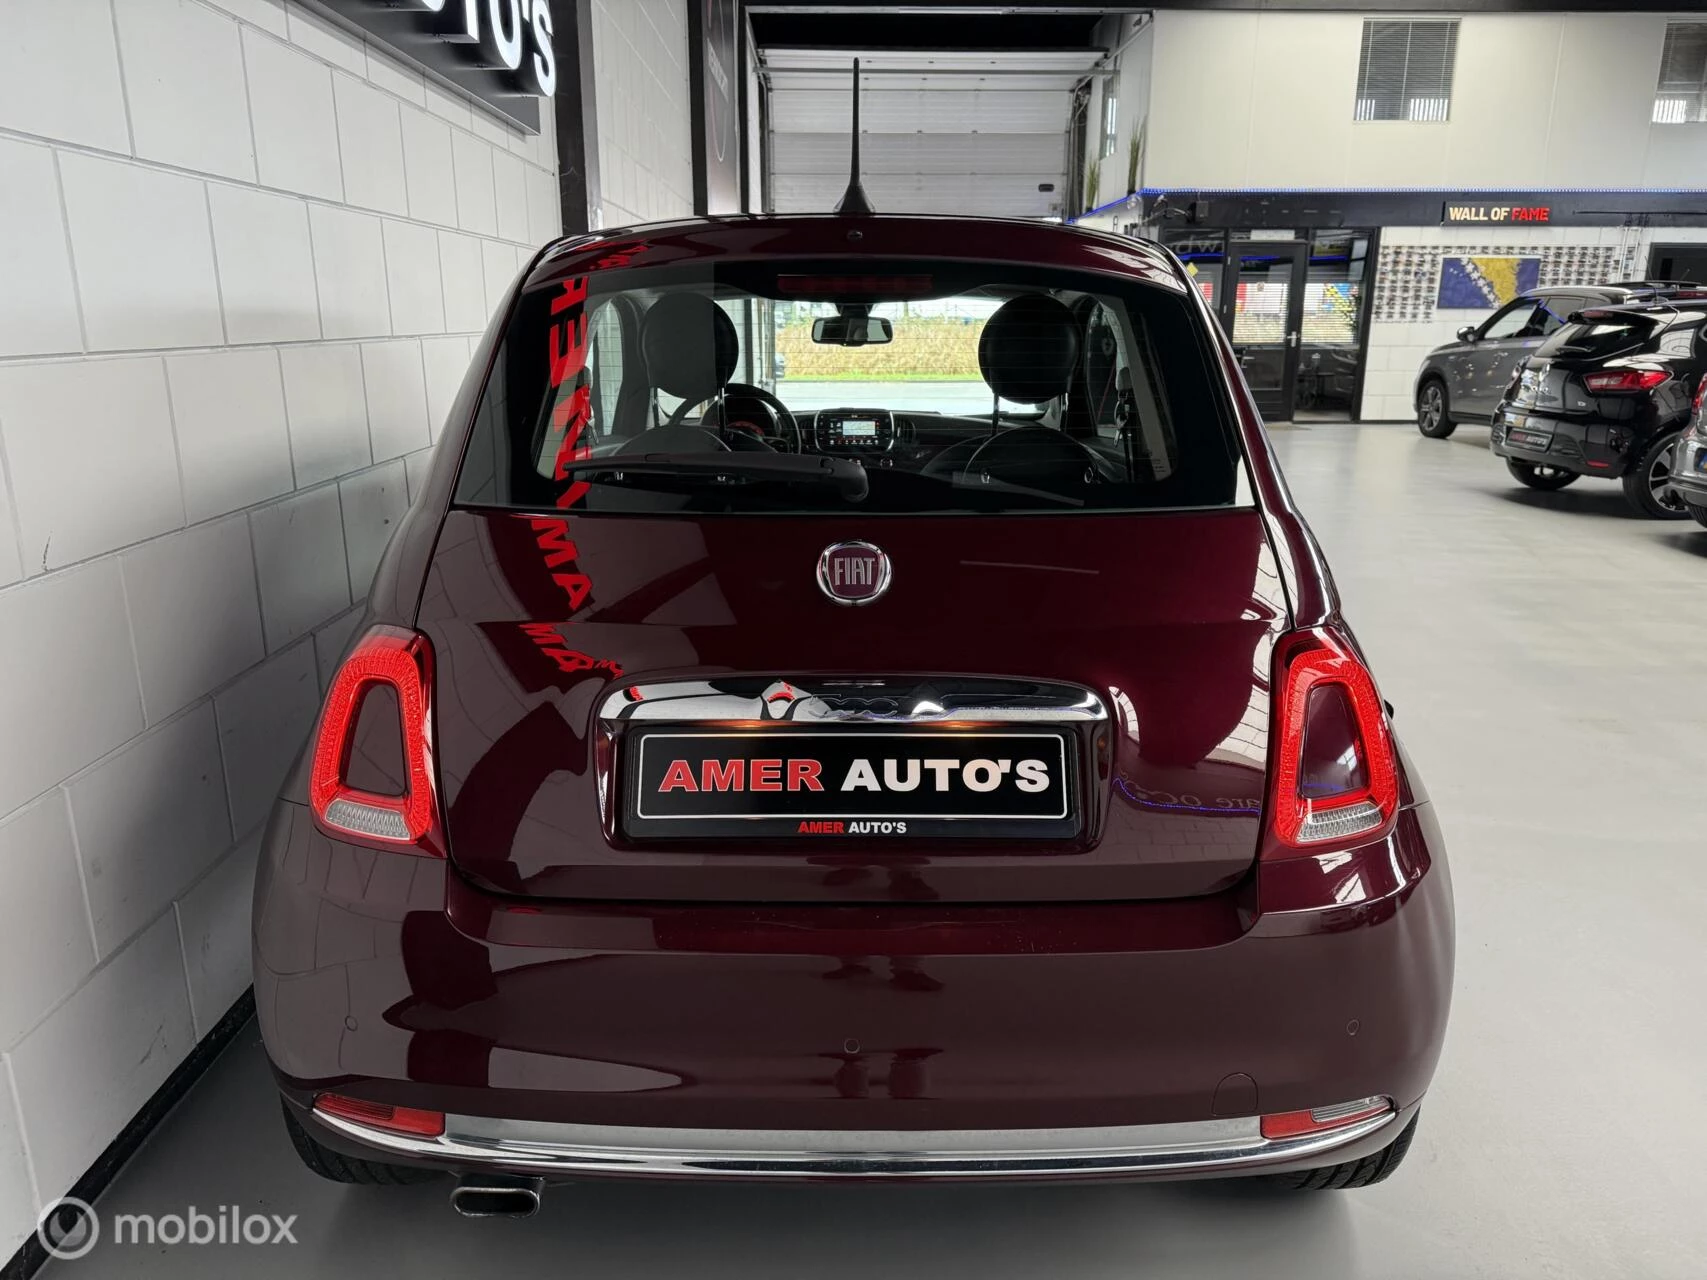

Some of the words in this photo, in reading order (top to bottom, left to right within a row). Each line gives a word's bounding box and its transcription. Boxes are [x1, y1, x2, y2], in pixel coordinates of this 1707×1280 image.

[1449, 207, 1488, 221] WALL
[1490, 207, 1510, 221] OF
[1511, 207, 1550, 222] FAME
[834, 557, 876, 586] FIAT
[658, 759, 825, 792] AMER
[840, 759, 1051, 792] AUTO'S
[797, 821, 845, 834] AMER
[848, 821, 908, 834] AUTO'S
